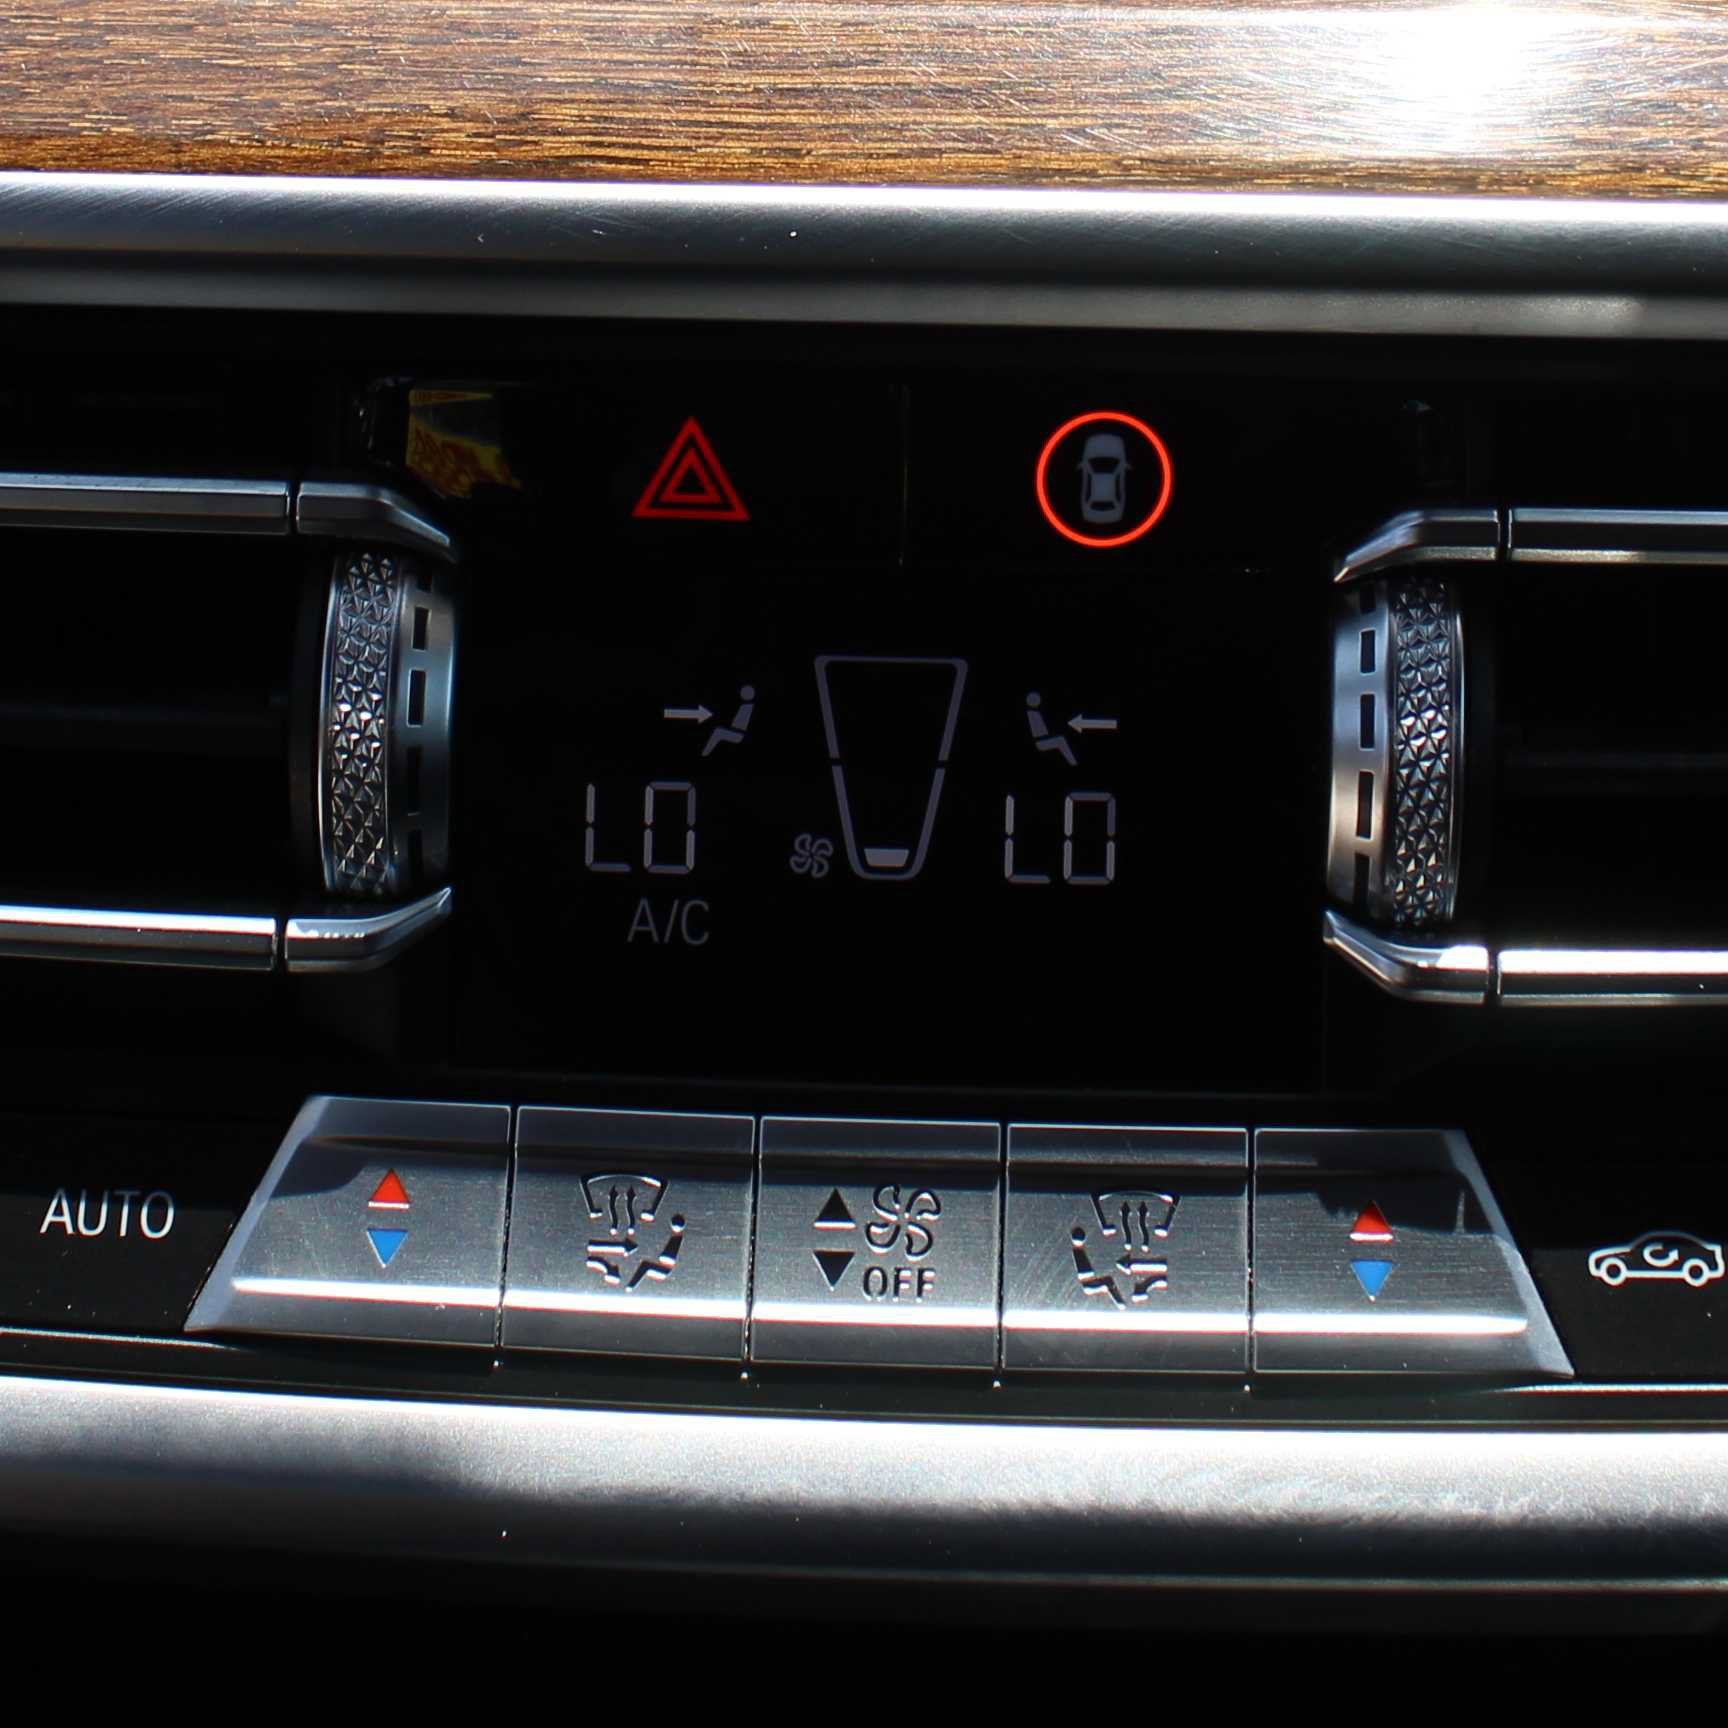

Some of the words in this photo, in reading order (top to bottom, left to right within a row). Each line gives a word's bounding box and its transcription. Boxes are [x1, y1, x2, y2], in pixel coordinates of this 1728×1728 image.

[584, 780, 697, 875] LO
[1004, 791, 1117, 886] LO
[626, 897, 710, 946] A/C
[38, 1187, 175, 1240] AUTO
[862, 1265, 938, 1301] OFF
